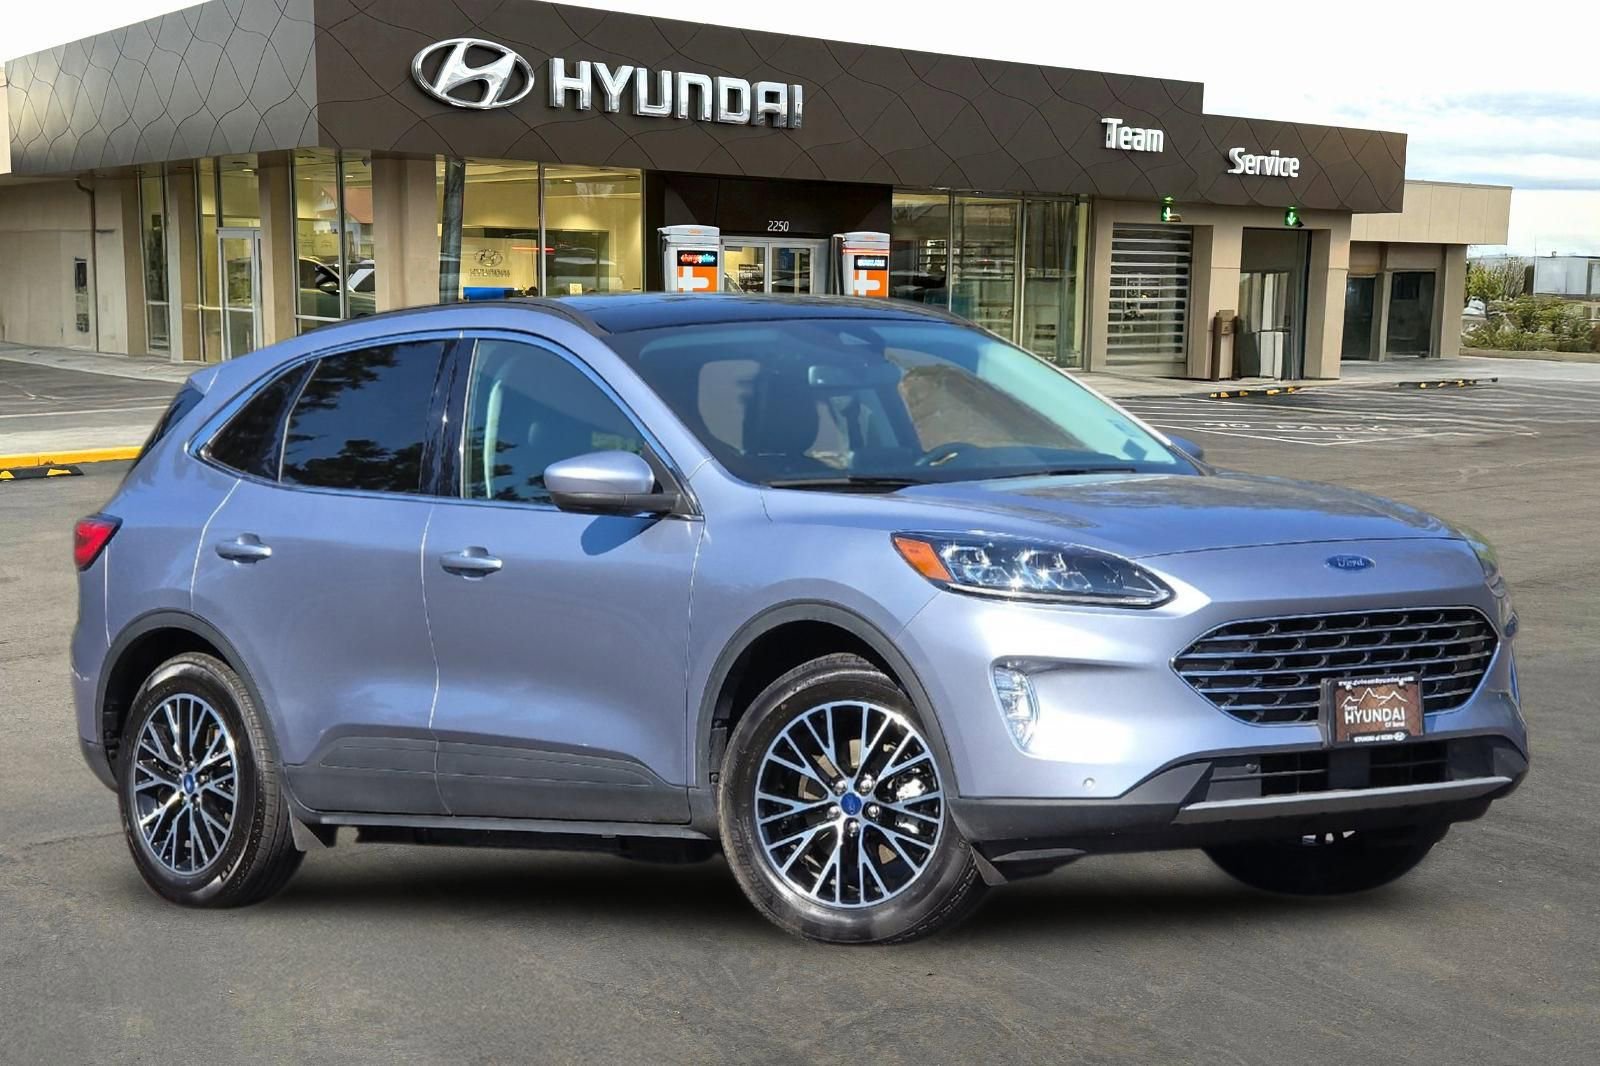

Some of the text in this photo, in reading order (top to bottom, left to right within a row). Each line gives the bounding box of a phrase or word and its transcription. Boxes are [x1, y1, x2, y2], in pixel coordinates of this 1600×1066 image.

[549, 57, 803, 129] HYUNDAI
[1101, 117, 1164, 152] Team
[1227, 147, 1300, 178] Service
[767, 220, 790, 232] 2250
[1344, 706, 1405, 724] HYUNDAI
